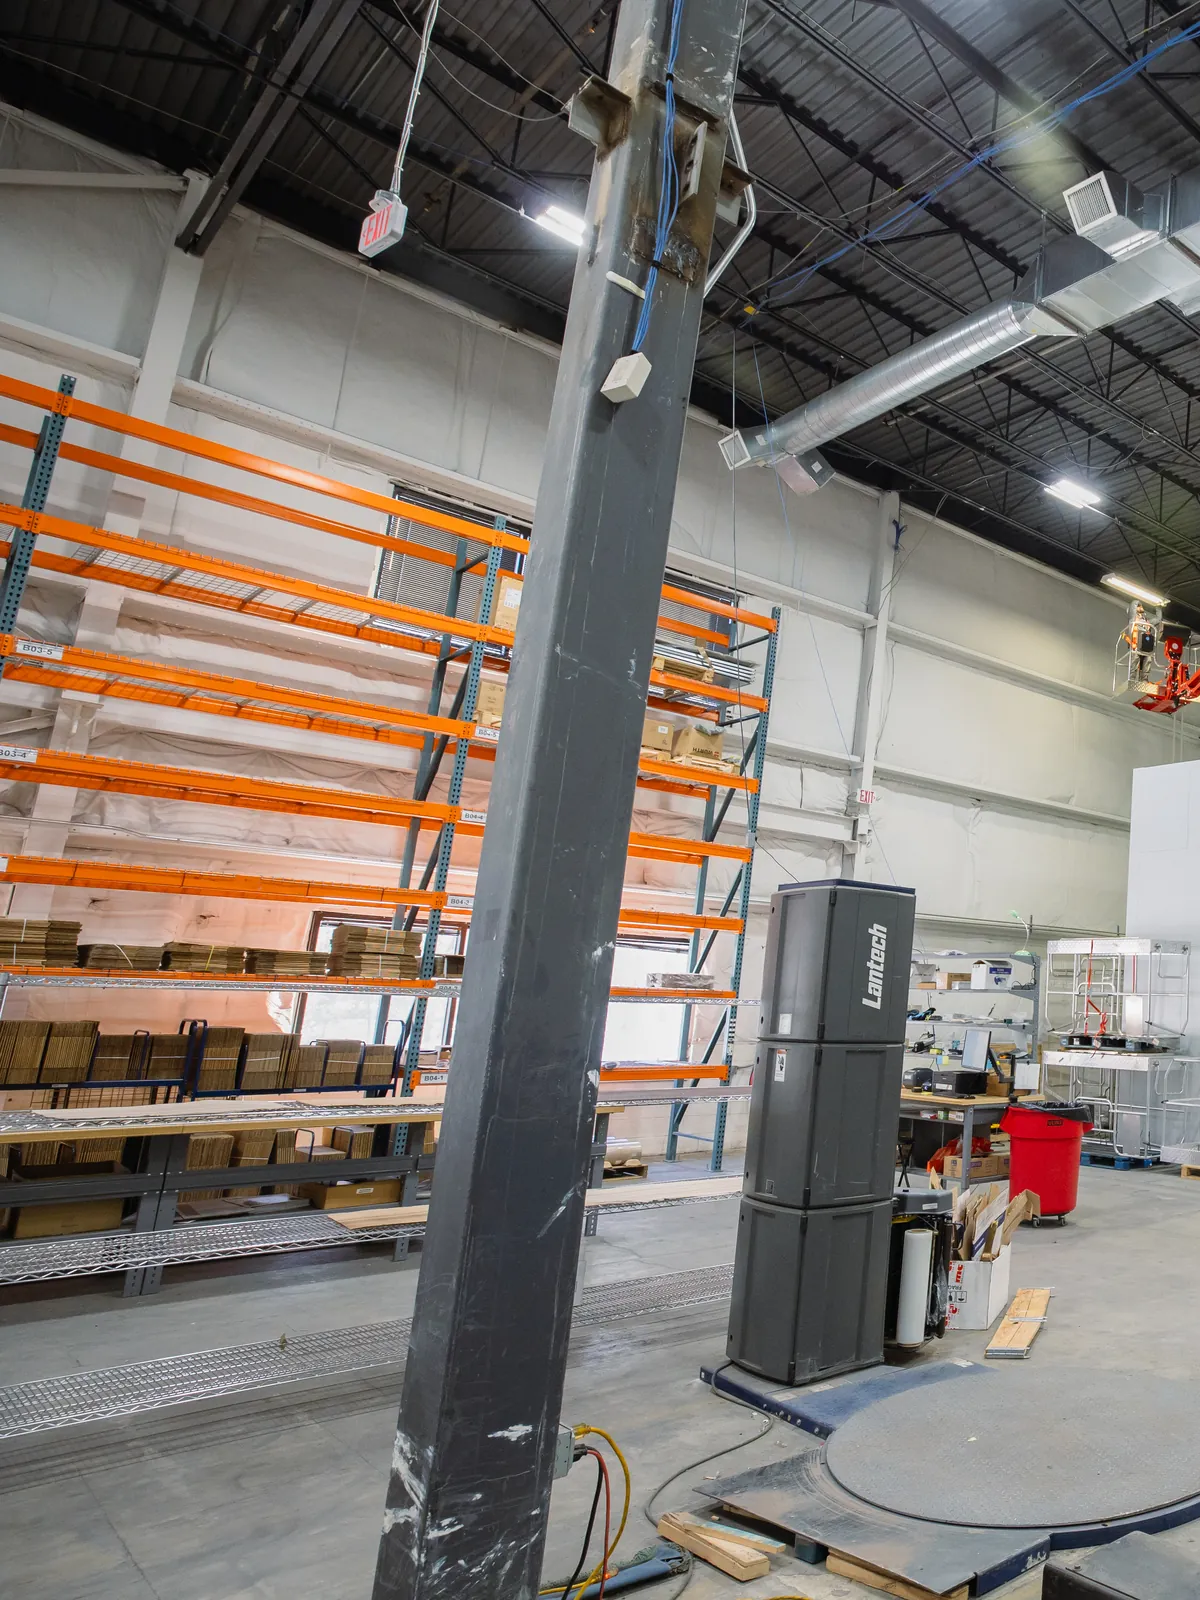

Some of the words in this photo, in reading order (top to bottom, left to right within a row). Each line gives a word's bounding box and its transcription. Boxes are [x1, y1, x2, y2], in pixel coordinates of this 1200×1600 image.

[364, 204, 392, 246] EXIT
[22, 644, 53, 656] B03-5
[860, 789, 875, 803] EXIT
[861, 923, 888, 1010] Lantech
